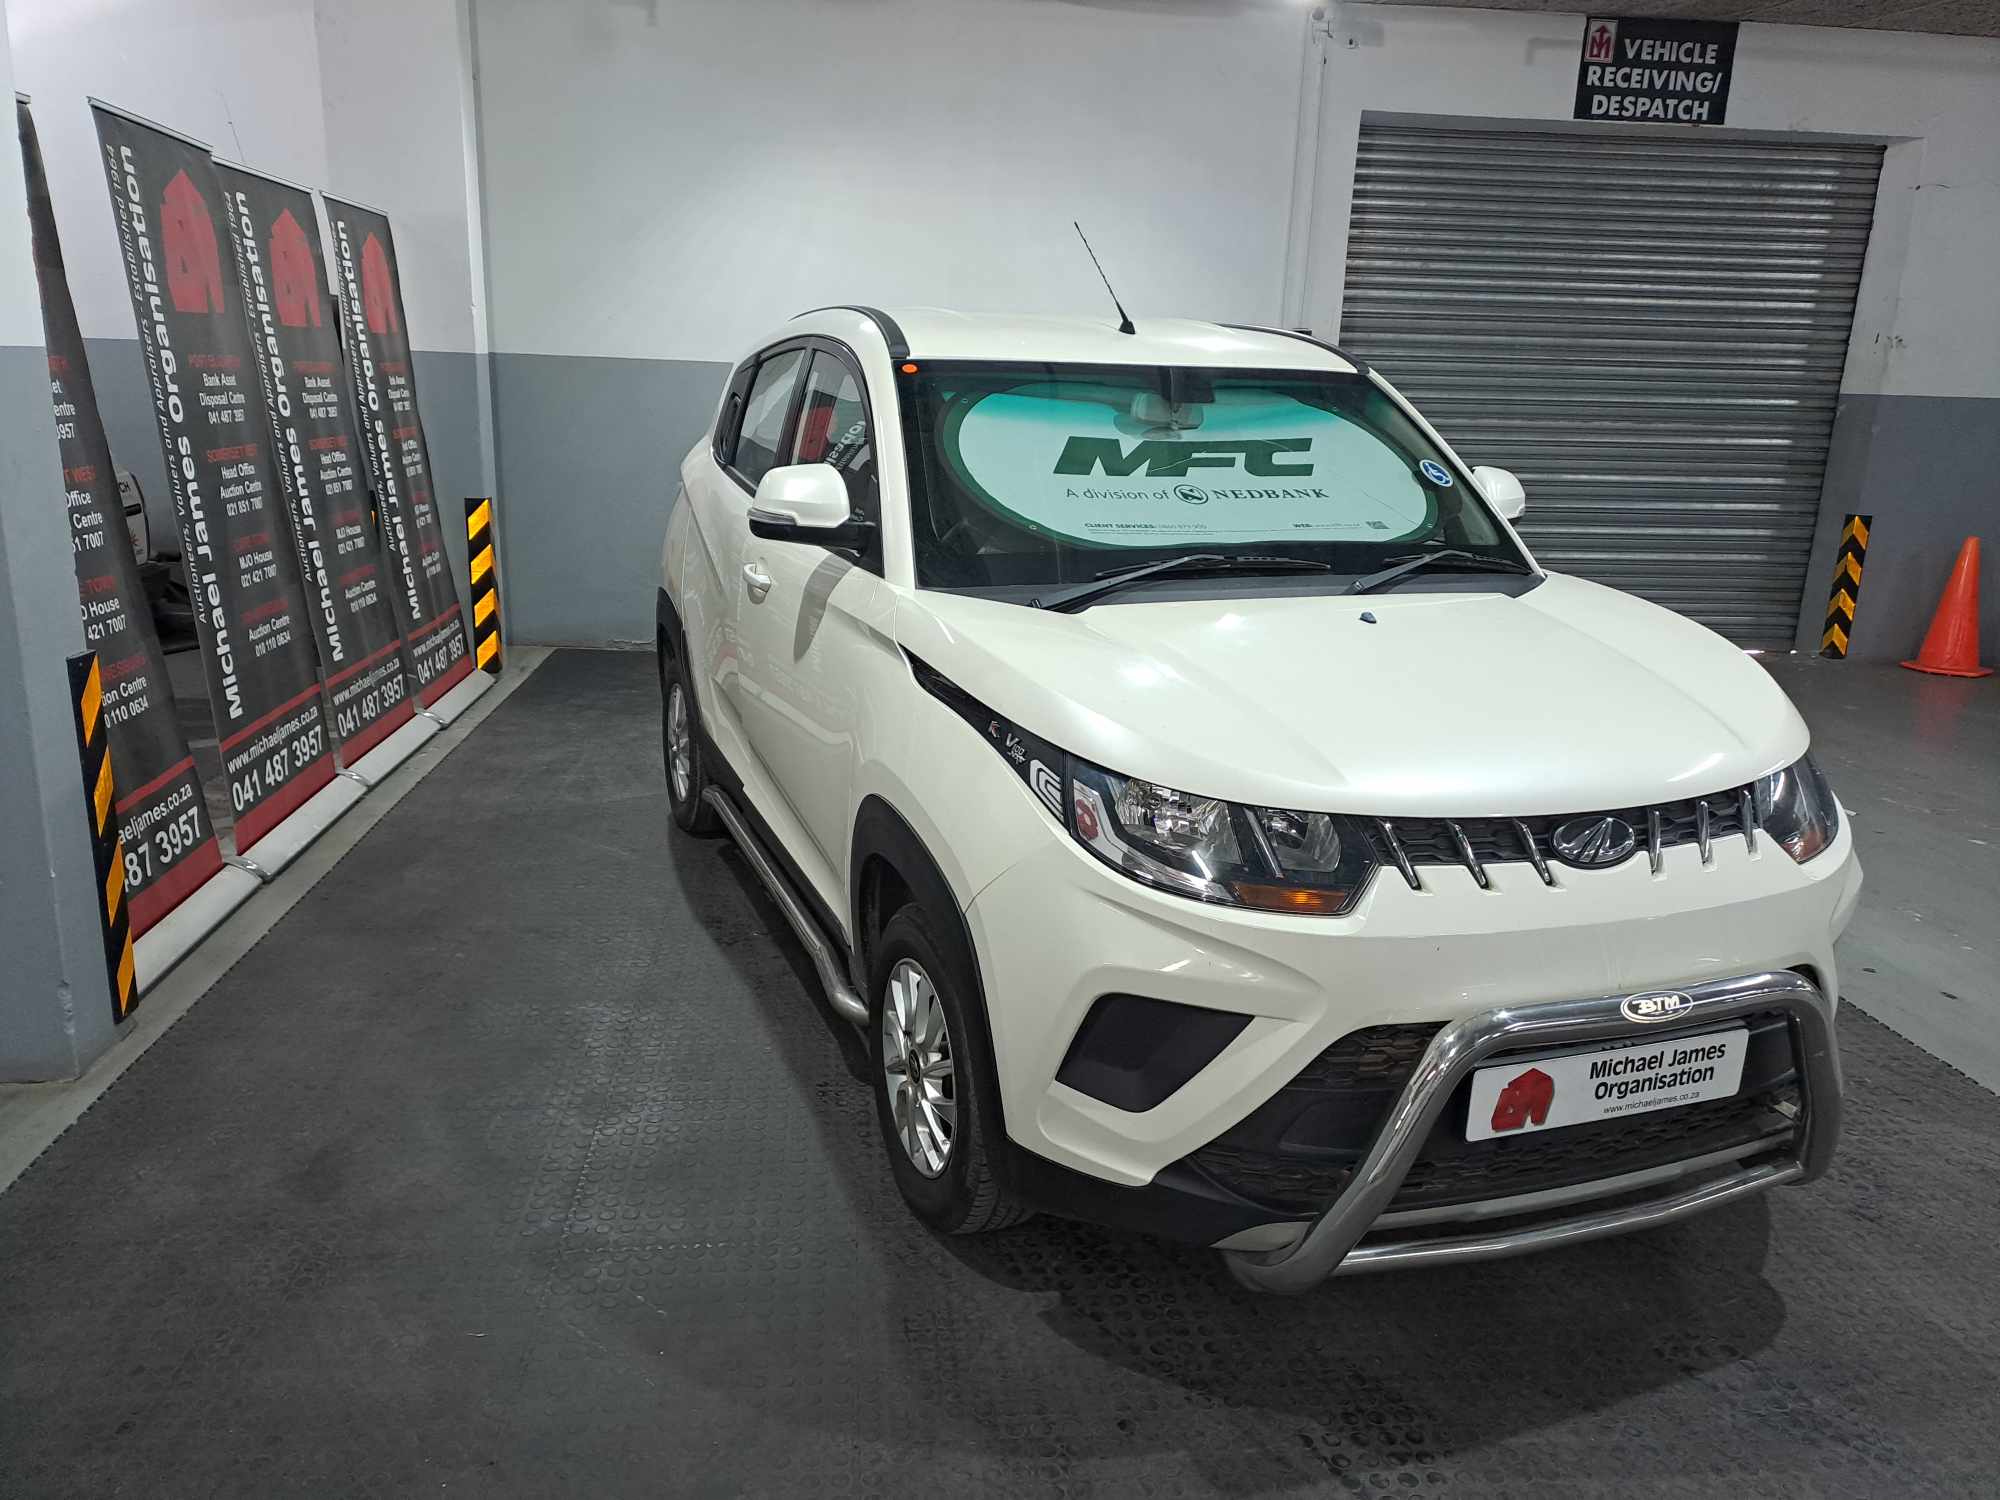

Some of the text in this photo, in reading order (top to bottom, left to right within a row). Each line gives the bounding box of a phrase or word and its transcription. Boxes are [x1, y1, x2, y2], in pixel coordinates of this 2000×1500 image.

[1624, 38, 1719, 64] VEHICLE
[1586, 65, 1722, 93] RECEIVING/
[1591, 94, 1709, 121] DESPATCH
[105, 143, 122, 190] 1964
[114, 199, 143, 301] Established
[336, 220, 379, 411] Organisation
[140, 318, 166, 412] Appraisers
[203, 373, 219, 387] Bank
[200, 391, 228, 407] Disposal
[208, 409, 219, 424] 041
[221, 409, 232, 423] 487
[236, 191, 344, 662] Michael James Organisation
[268, 409, 281, 439] and
[359, 406, 371, 430] and
[120, 145, 243, 720] Michael James Organisation
[159, 415, 172, 449] and
[221, 462, 256, 480] Head Office
[275, 442, 292, 493] Valuers
[374, 420, 399, 509] James
[1052, 436, 1315, 478] MFC
[168, 455, 186, 516] Valuers
[220, 482, 245, 499] Auction
[1065, 488, 1331, 500] A division of NEDBANK
[73, 512, 103, 529] Centre
[226, 502, 238, 517] 021
[238, 500, 250, 514] 851
[83, 531, 104, 550] 7007
[254, 551, 273, 566] House
[392, 515, 422, 620] Michael
[241, 573, 252, 588] 021
[251, 569, 263, 584] 421
[89, 597, 121, 620] House
[87, 614, 127, 641] 421 7007
[249, 615, 290, 642] Auction Centre
[266, 637, 276, 652] 110
[417, 633, 465, 685] 041 487 3957
[120, 676, 148, 698] Centre
[111, 706, 129, 726] 110
[130, 695, 149, 716] 0634
[337, 673, 405, 738] 041 487 3957
[227, 705, 318, 774] www.michaeljames.co.za
[232, 725, 323, 812] 041 487 3957
[124, 806, 201, 893] 87 3957
[1589, 1043, 1727, 1080] Michael James
[1595, 1065, 1715, 1100] Organisation
[1603, 1091, 1700, 1114] www.michaeljames.co.za
